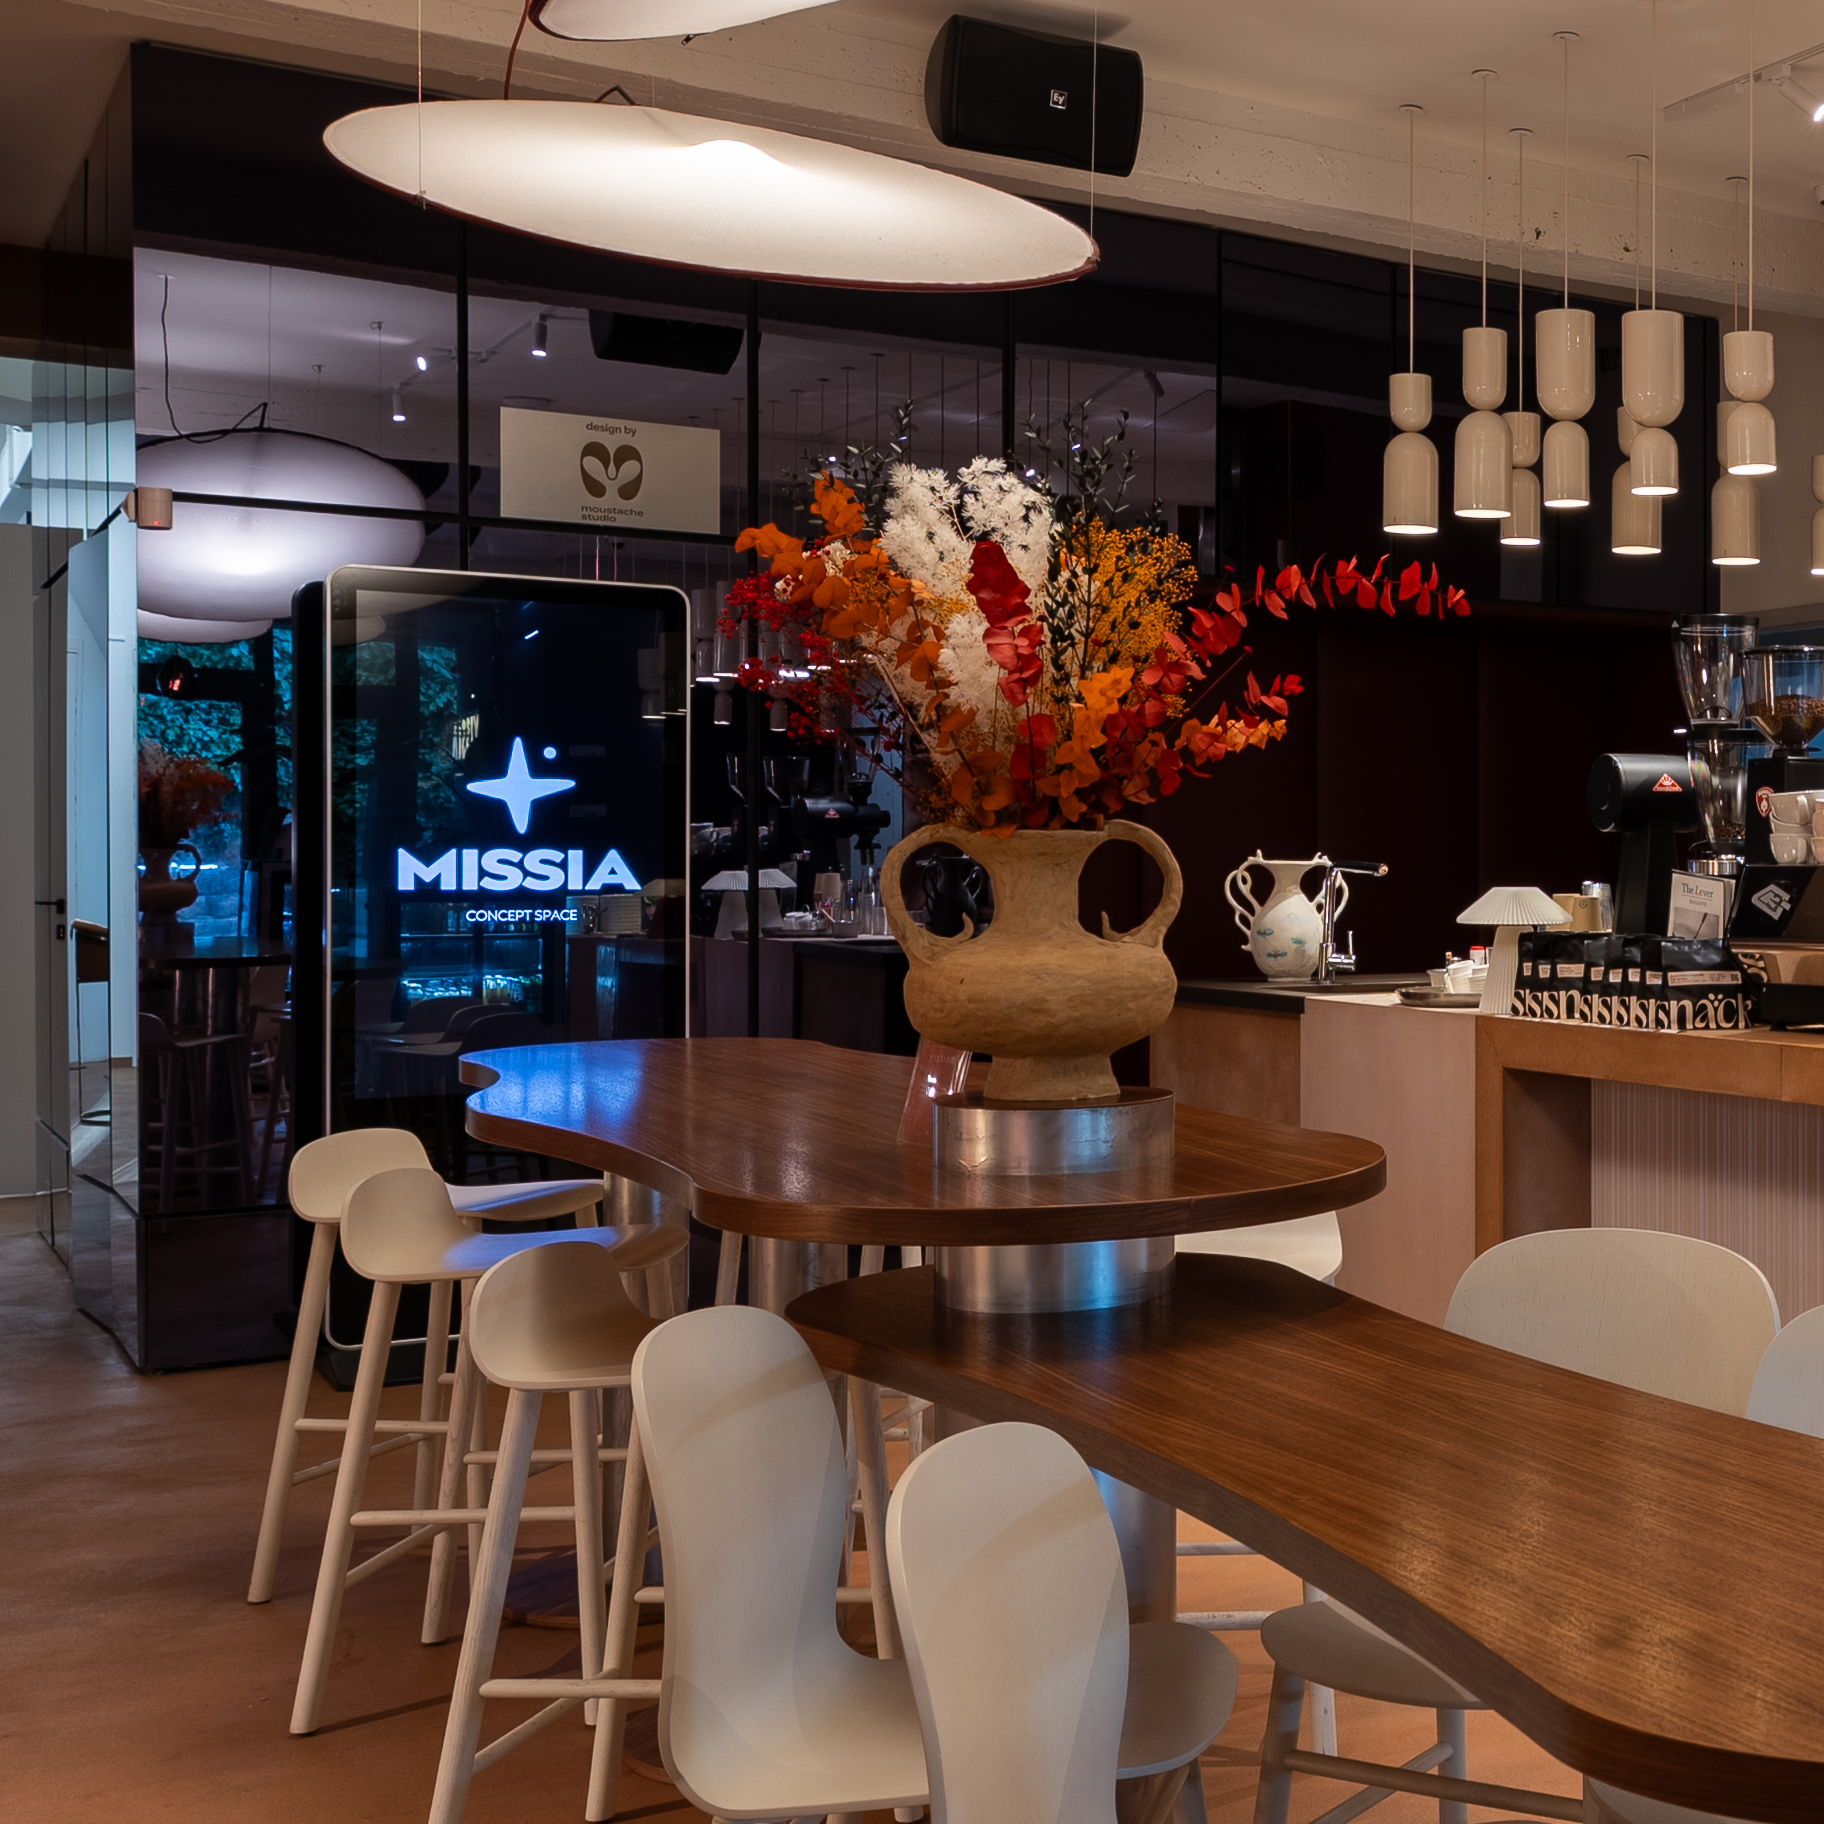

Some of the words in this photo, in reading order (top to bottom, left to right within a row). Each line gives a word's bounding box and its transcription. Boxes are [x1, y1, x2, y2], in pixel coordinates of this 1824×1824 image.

[585, 421, 622, 435] design
[623, 425, 638, 437] by
[580, 505, 644, 517] moustache
[580, 514, 617, 523] studio
[397, 847, 642, 891] MISSIA
[1682, 882, 1694, 895] The
[1695, 885, 1714, 899] Lever
[466, 909, 532, 922] CONCEPT
[534, 909, 578, 922] SPACE
